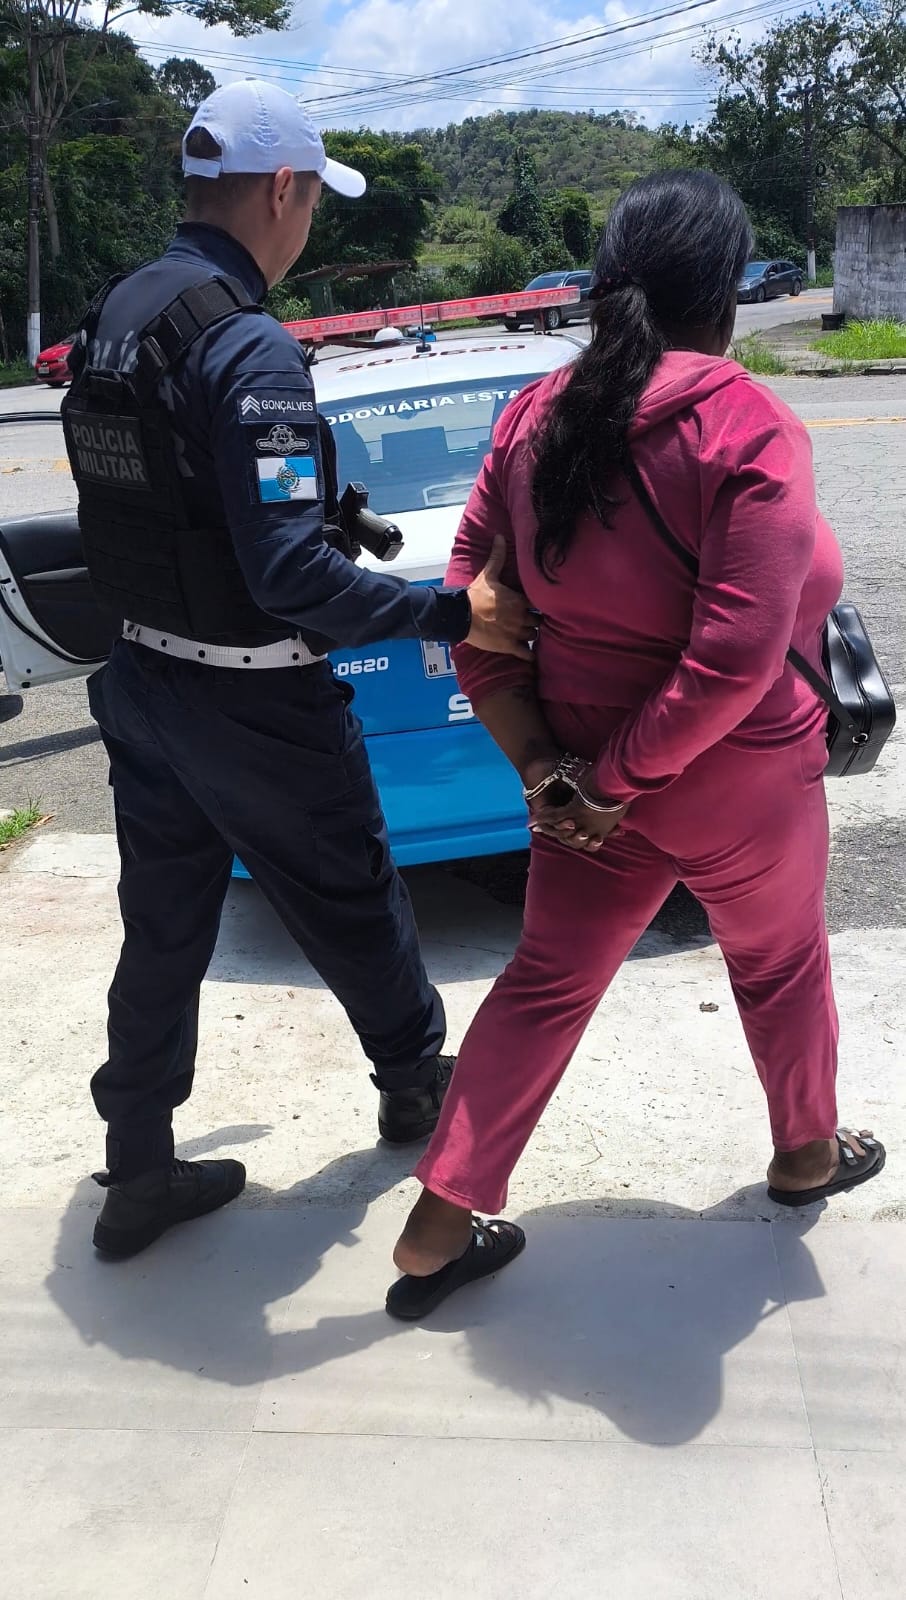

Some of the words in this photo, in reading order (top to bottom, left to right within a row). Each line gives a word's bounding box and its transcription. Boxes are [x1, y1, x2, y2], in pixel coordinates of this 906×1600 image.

[338, 345, 525, 371] SO-0620
[261, 399, 314, 413] GONÇALVES
[71, 422, 140, 455] POLÍCIA
[77, 450, 147, 481] MILITAR
[428, 663, 439, 674] BR
